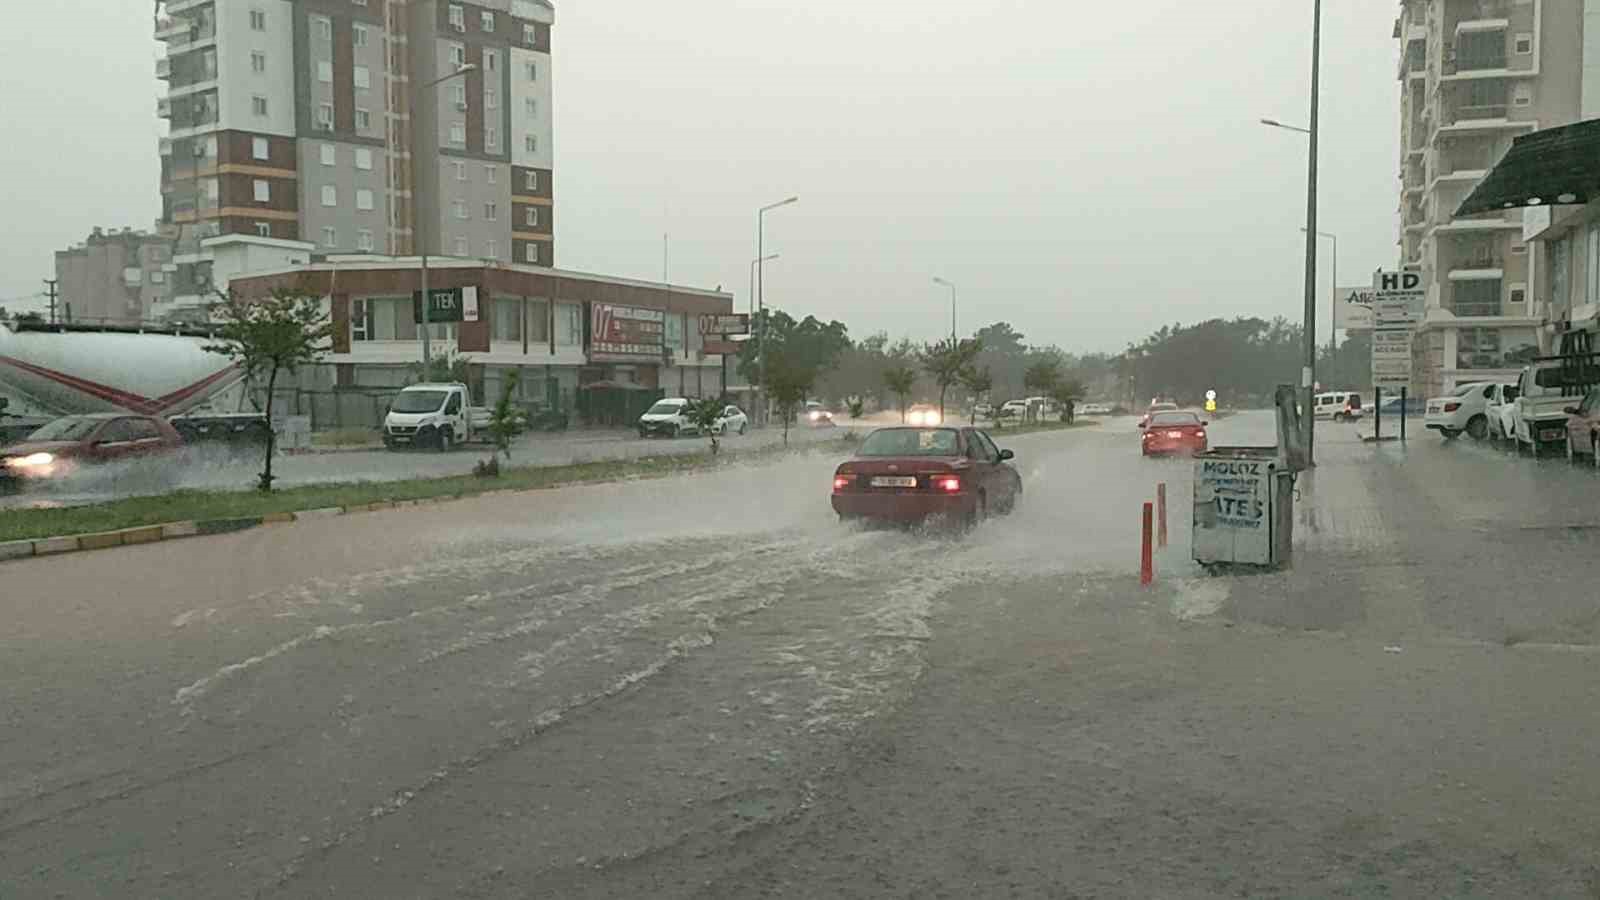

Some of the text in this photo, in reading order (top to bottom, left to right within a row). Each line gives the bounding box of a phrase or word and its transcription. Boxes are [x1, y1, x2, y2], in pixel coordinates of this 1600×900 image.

[1381, 273, 1420, 290] HD
[434, 293, 456, 309] TEK
[593, 304, 613, 341] 07
[1203, 462, 1261, 475] MOLOZ
